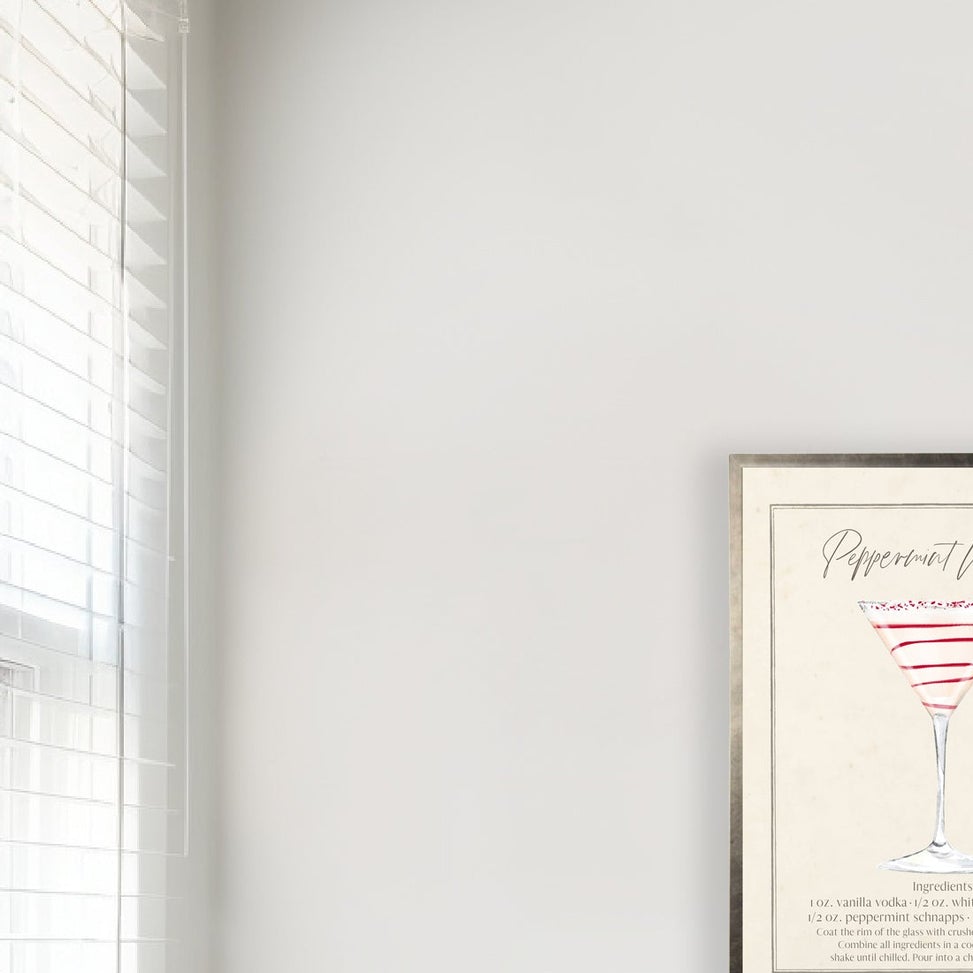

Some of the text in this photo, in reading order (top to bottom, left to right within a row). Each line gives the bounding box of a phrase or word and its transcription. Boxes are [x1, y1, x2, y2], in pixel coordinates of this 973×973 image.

[822, 529, 965, 581] Peppermint
[913, 881, 972, 894] Ingredients
[816, 899, 833, 907] oz.
[837, 897, 872, 907] vanilla
[876, 897, 907, 907] vodka
[914, 897, 928, 908] 1/2
[932, 899, 948, 907] oz.
[808, 912, 822, 923] 1/2
[825, 914, 842, 922] oz.
[846, 912, 909, 925] peppermint
[914, 912, 964, 925] schnapps
[817, 928, 837, 936] Coat
[841, 928, 854, 936] the
[857, 928, 872, 936] rim
[875, 928, 884, 936] of
[887, 928, 900, 936] the
[903, 928, 924, 938] glass
[926, 928, 945, 936] with
[838, 940, 877, 949] Combine
[880, 940, 890, 949] all
[893, 940, 940, 951] ingredients
[943, 940, 951, 949] in
[831, 953, 854, 962] shake
[857, 953, 876, 961] until
[879, 953, 910, 961] chilled.
